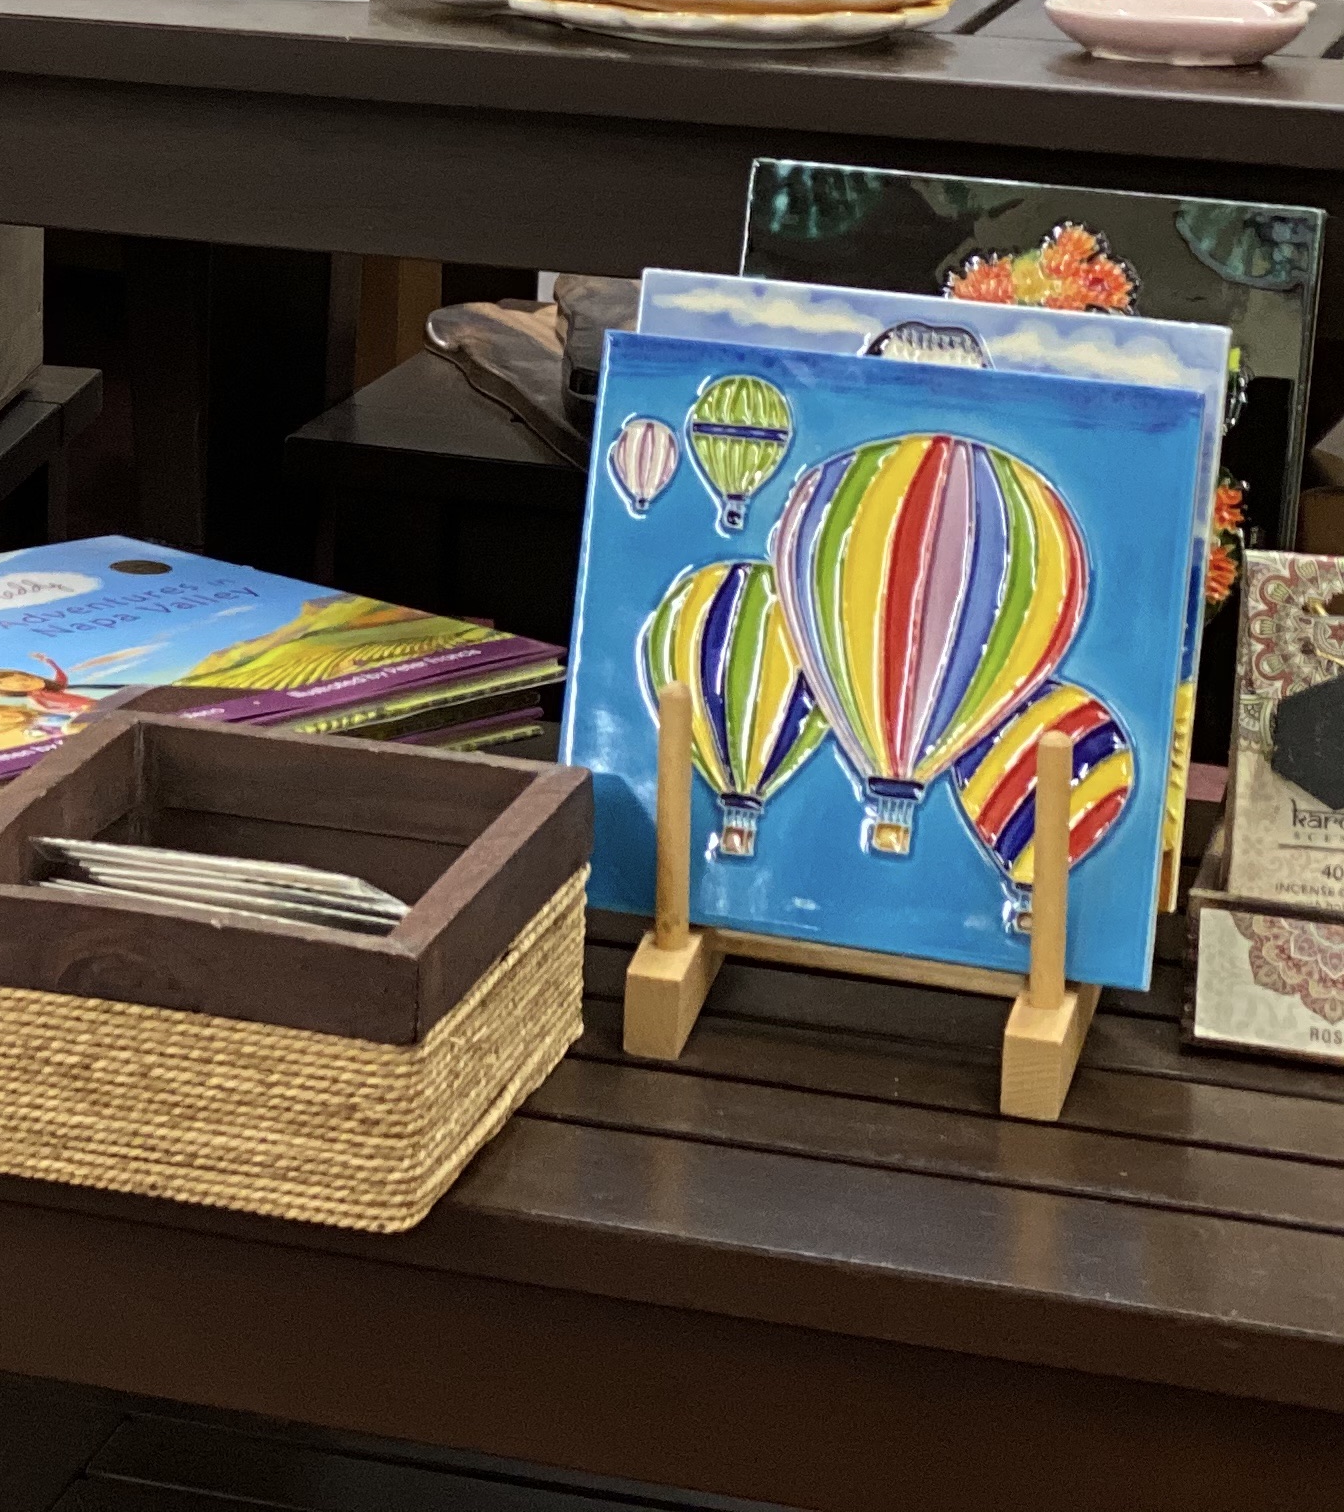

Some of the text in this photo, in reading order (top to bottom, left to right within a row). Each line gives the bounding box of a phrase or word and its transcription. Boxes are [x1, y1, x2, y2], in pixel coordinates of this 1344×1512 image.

[29, 584, 261, 639] Napa Valley
[1309, 1025, 1344, 1044] ROS
